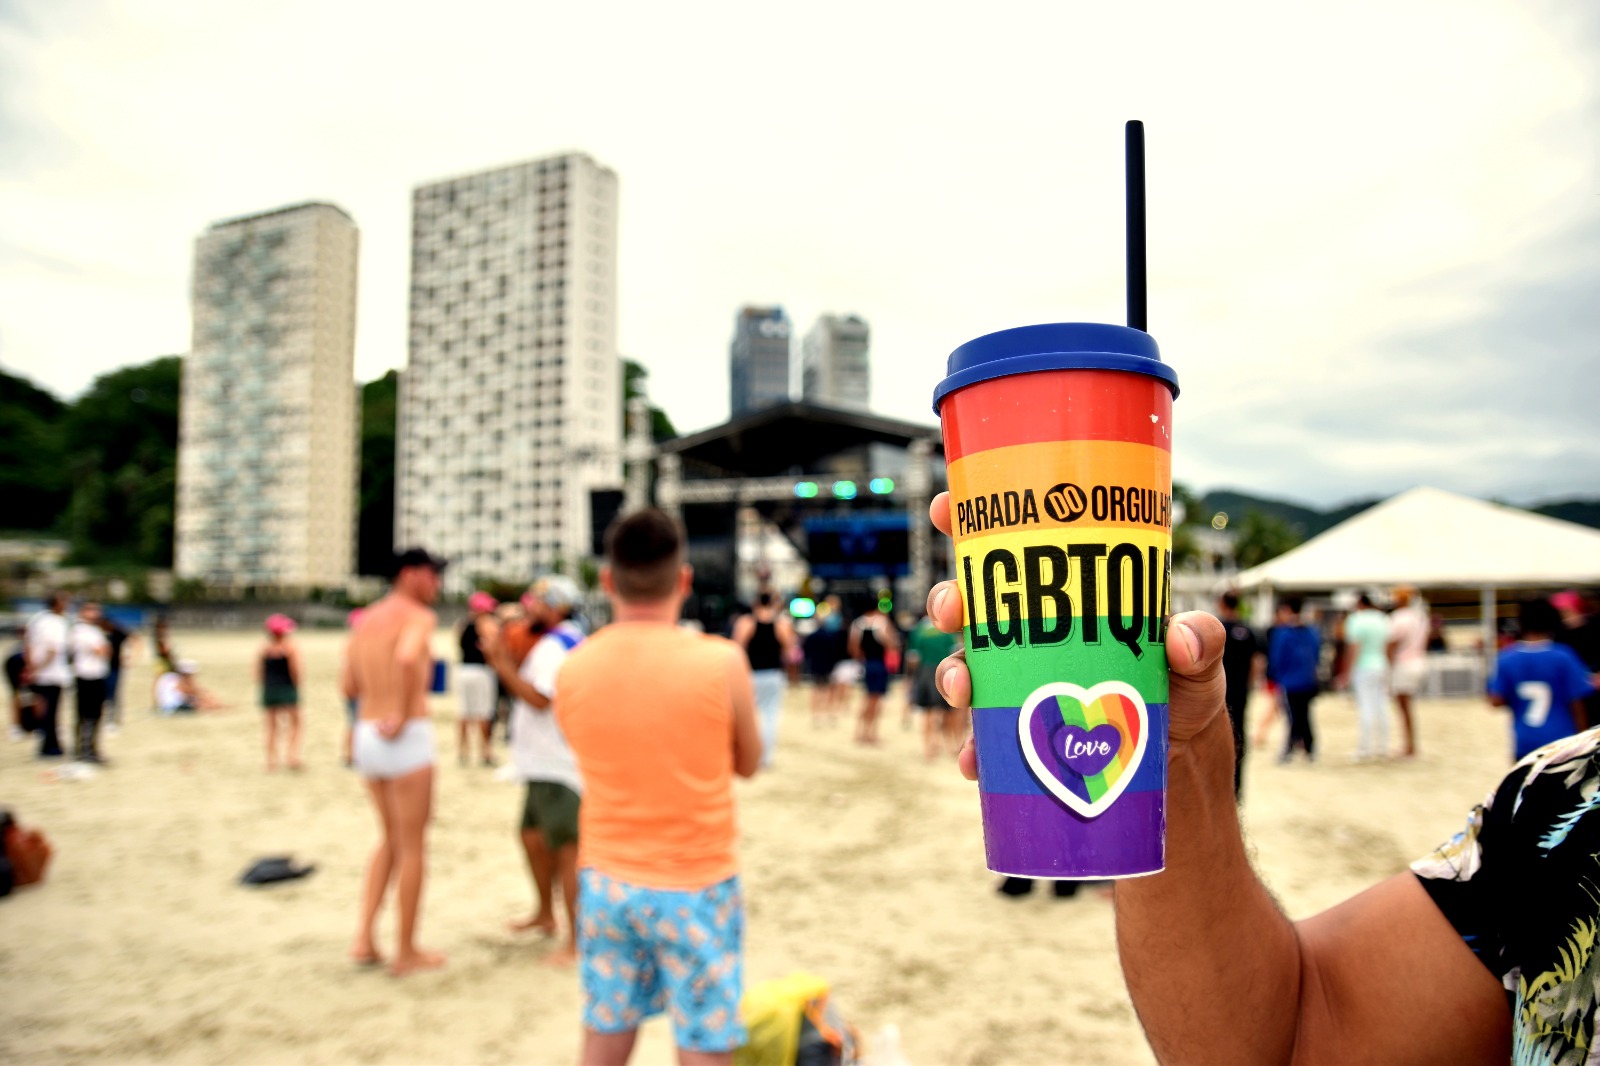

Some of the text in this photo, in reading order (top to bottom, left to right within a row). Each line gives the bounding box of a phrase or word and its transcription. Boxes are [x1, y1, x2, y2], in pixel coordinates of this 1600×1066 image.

[957, 488, 1040, 536] PARADA
[1048, 485, 1084, 520] DO
[1516, 681, 1552, 728] 7
[1064, 733, 1111, 759] Love
